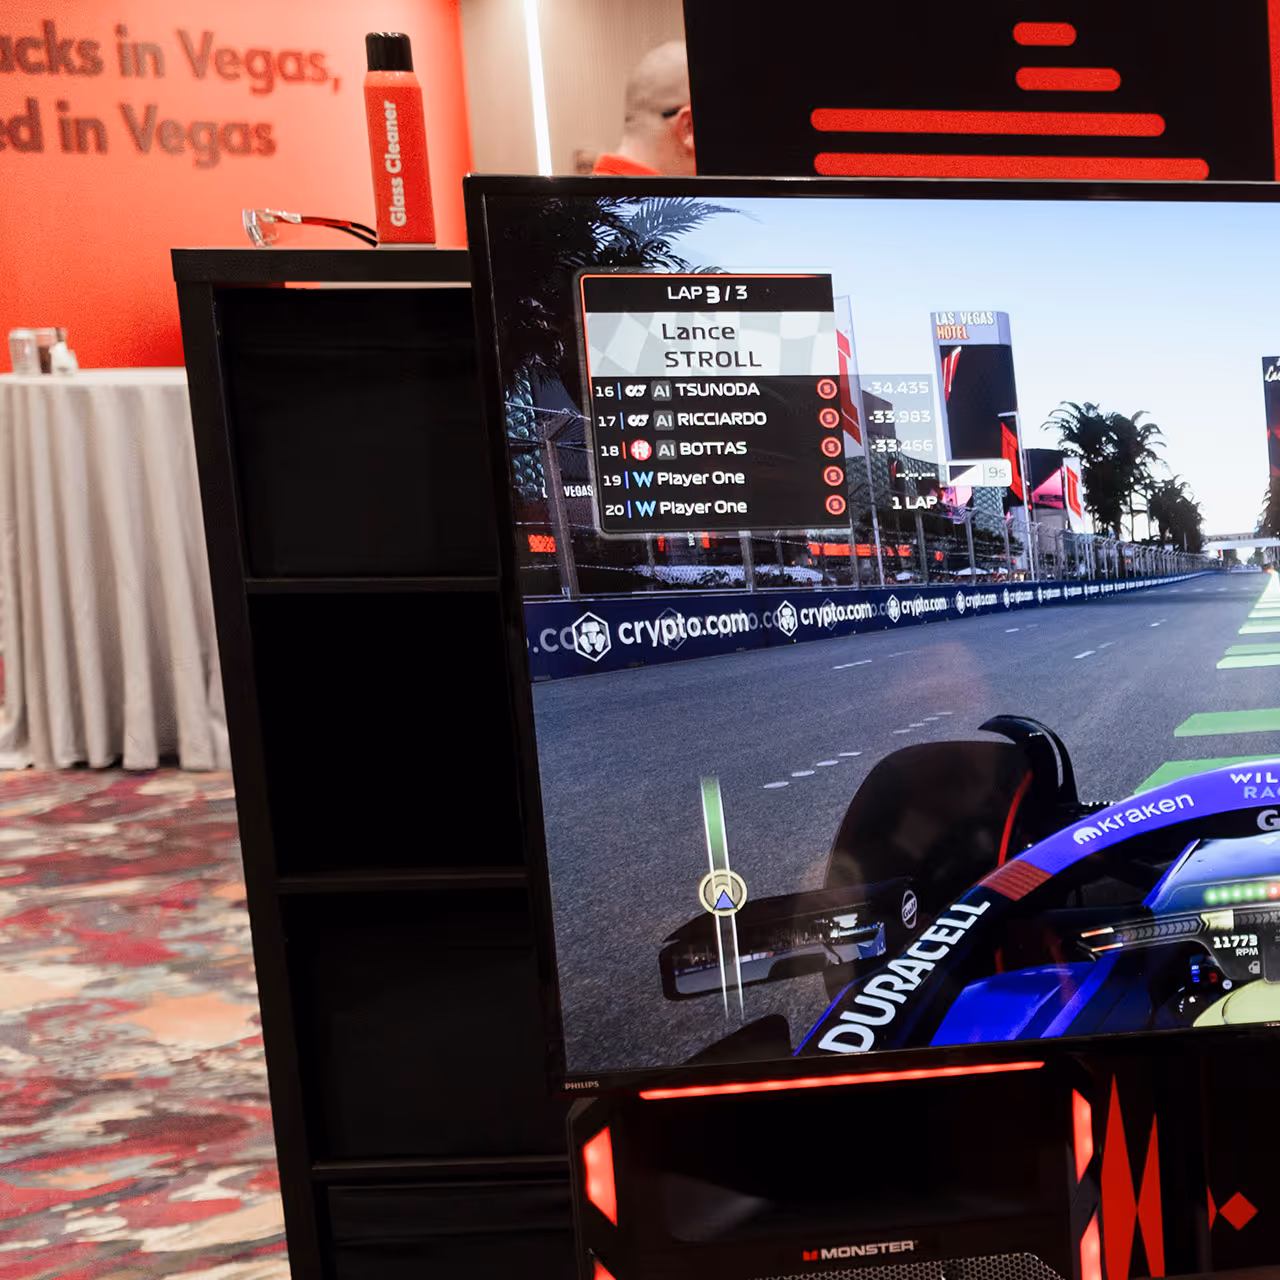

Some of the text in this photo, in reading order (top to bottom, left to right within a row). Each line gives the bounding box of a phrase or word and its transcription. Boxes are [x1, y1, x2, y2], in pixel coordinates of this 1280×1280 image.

[116, 24, 166, 79] in
[175, 30, 341, 93] Vegas,
[58, 100, 108, 155] in
[118, 105, 276, 168] Vegas
[384, 100, 407, 226] Glass Cleaner
[667, 285, 703, 300] LAP
[935, 311, 994, 325] LAS VEGAS
[662, 323, 735, 341] Lance
[936, 325, 969, 339] HOTEL
[664, 350, 762, 369] STROLL
[595, 386, 615, 397] 16
[675, 383, 760, 397] TSUNODA
[598, 415, 617, 428] 17
[677, 412, 767, 426] RICCIARDO
[601, 445, 620, 457] 18
[680, 441, 748, 456] BOTTAS
[603, 475, 622, 487] 19
[657, 472, 709, 489] Player
[712, 471, 745, 486] One
[563, 486, 594, 498] VEGAS
[605, 504, 625, 516] 20
[659, 501, 713, 518] Player
[715, 500, 748, 514] One
[904, 496, 938, 509] LAP
[800, 601, 873, 628] crypto.com
[901, 597, 947, 616] crypto.com
[618, 610, 750, 648] crypto.com
[1099, 793, 1195, 833] kraken
[1236, 947, 1258, 957] RPM
[817, 900, 991, 1053] DURACELL
[821, 1240, 915, 1260] MONSTER
